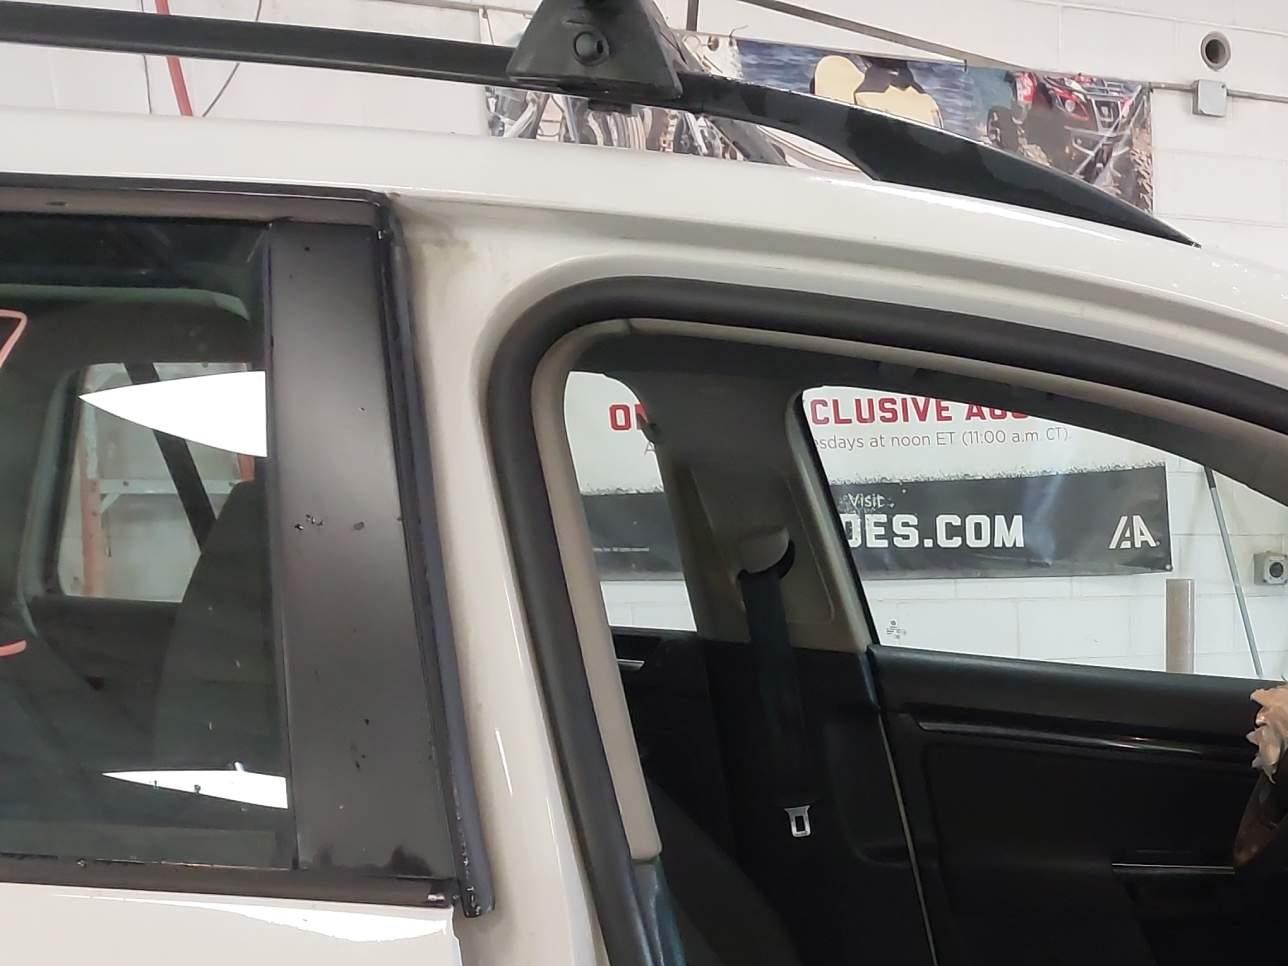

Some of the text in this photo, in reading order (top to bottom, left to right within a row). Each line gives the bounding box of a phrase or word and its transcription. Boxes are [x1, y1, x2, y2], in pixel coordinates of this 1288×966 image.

[869, 435, 887, 448] at
[891, 435, 931, 447] noon
[936, 431, 956, 446] ET
[962, 430, 1006, 447] (11:00
